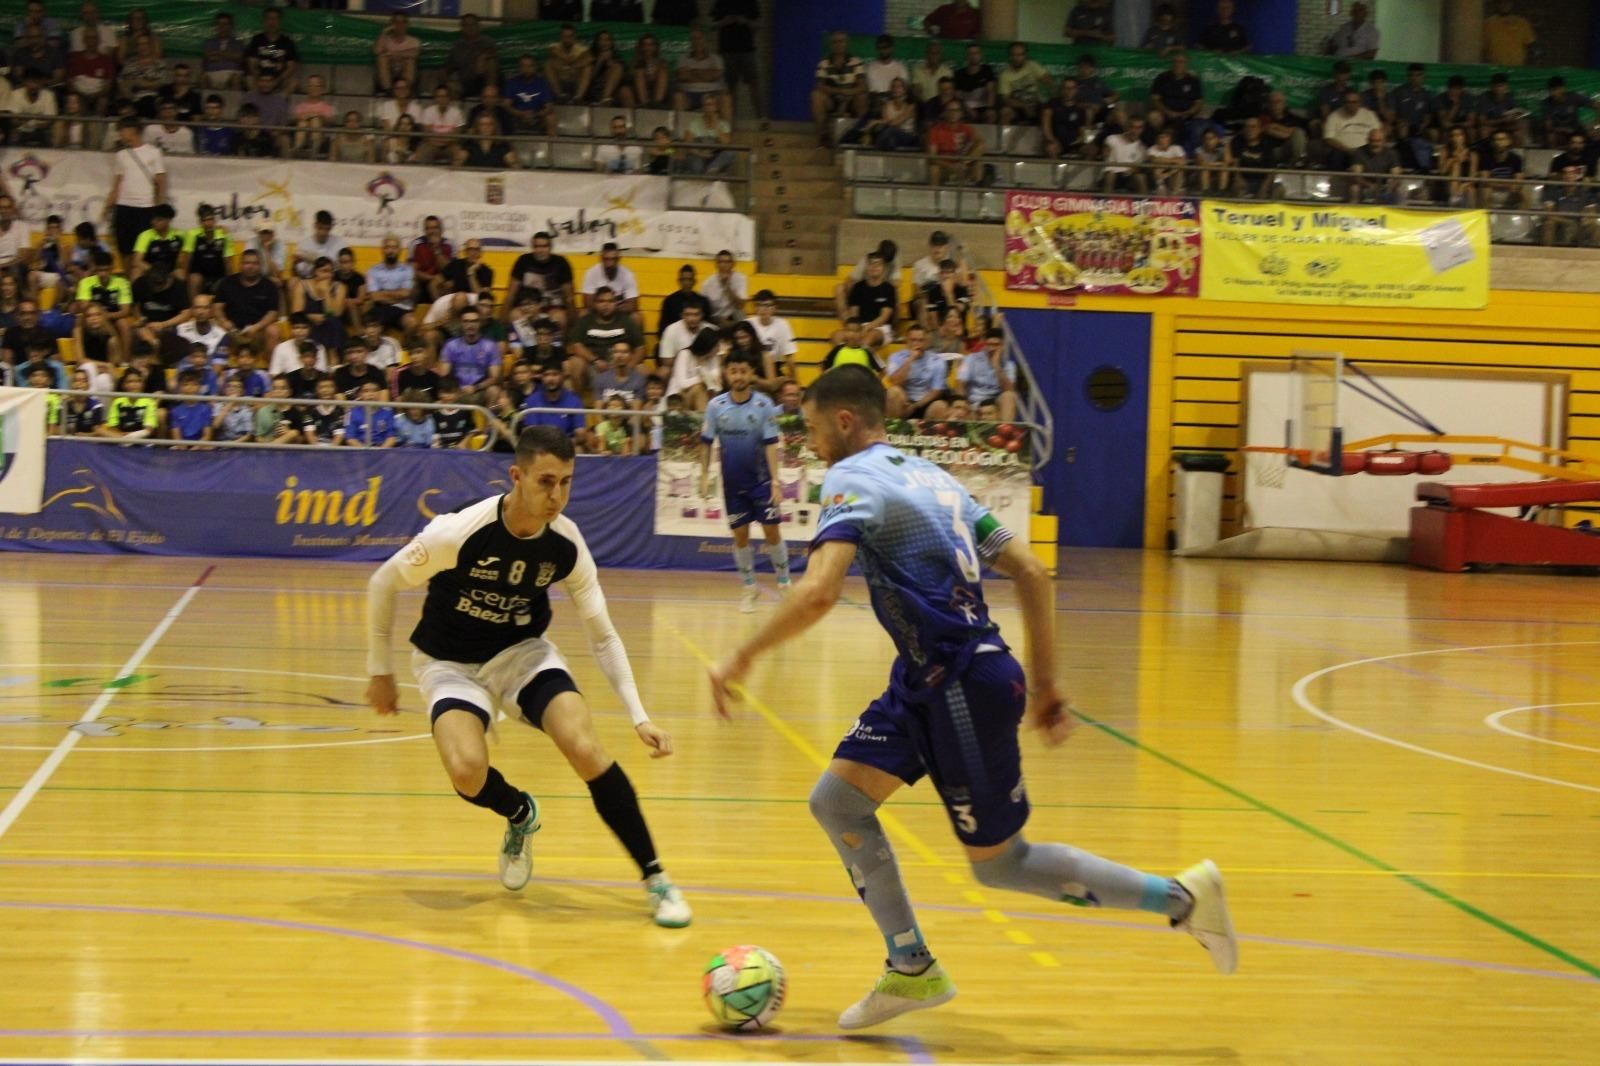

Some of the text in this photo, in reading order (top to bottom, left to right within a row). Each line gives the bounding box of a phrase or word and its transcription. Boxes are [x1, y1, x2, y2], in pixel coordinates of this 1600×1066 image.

[1012, 194, 1050, 209] CLUB
[1053, 197, 1130, 214] GIMNASIA
[1212, 208, 1388, 232] Teruel y Miguel
[921, 447, 1019, 466] ECOLÓGICA
[275, 475, 383, 527] imd
[936, 489, 980, 583] 3
[508, 560, 526, 586] 8
[952, 804, 978, 834] 3
